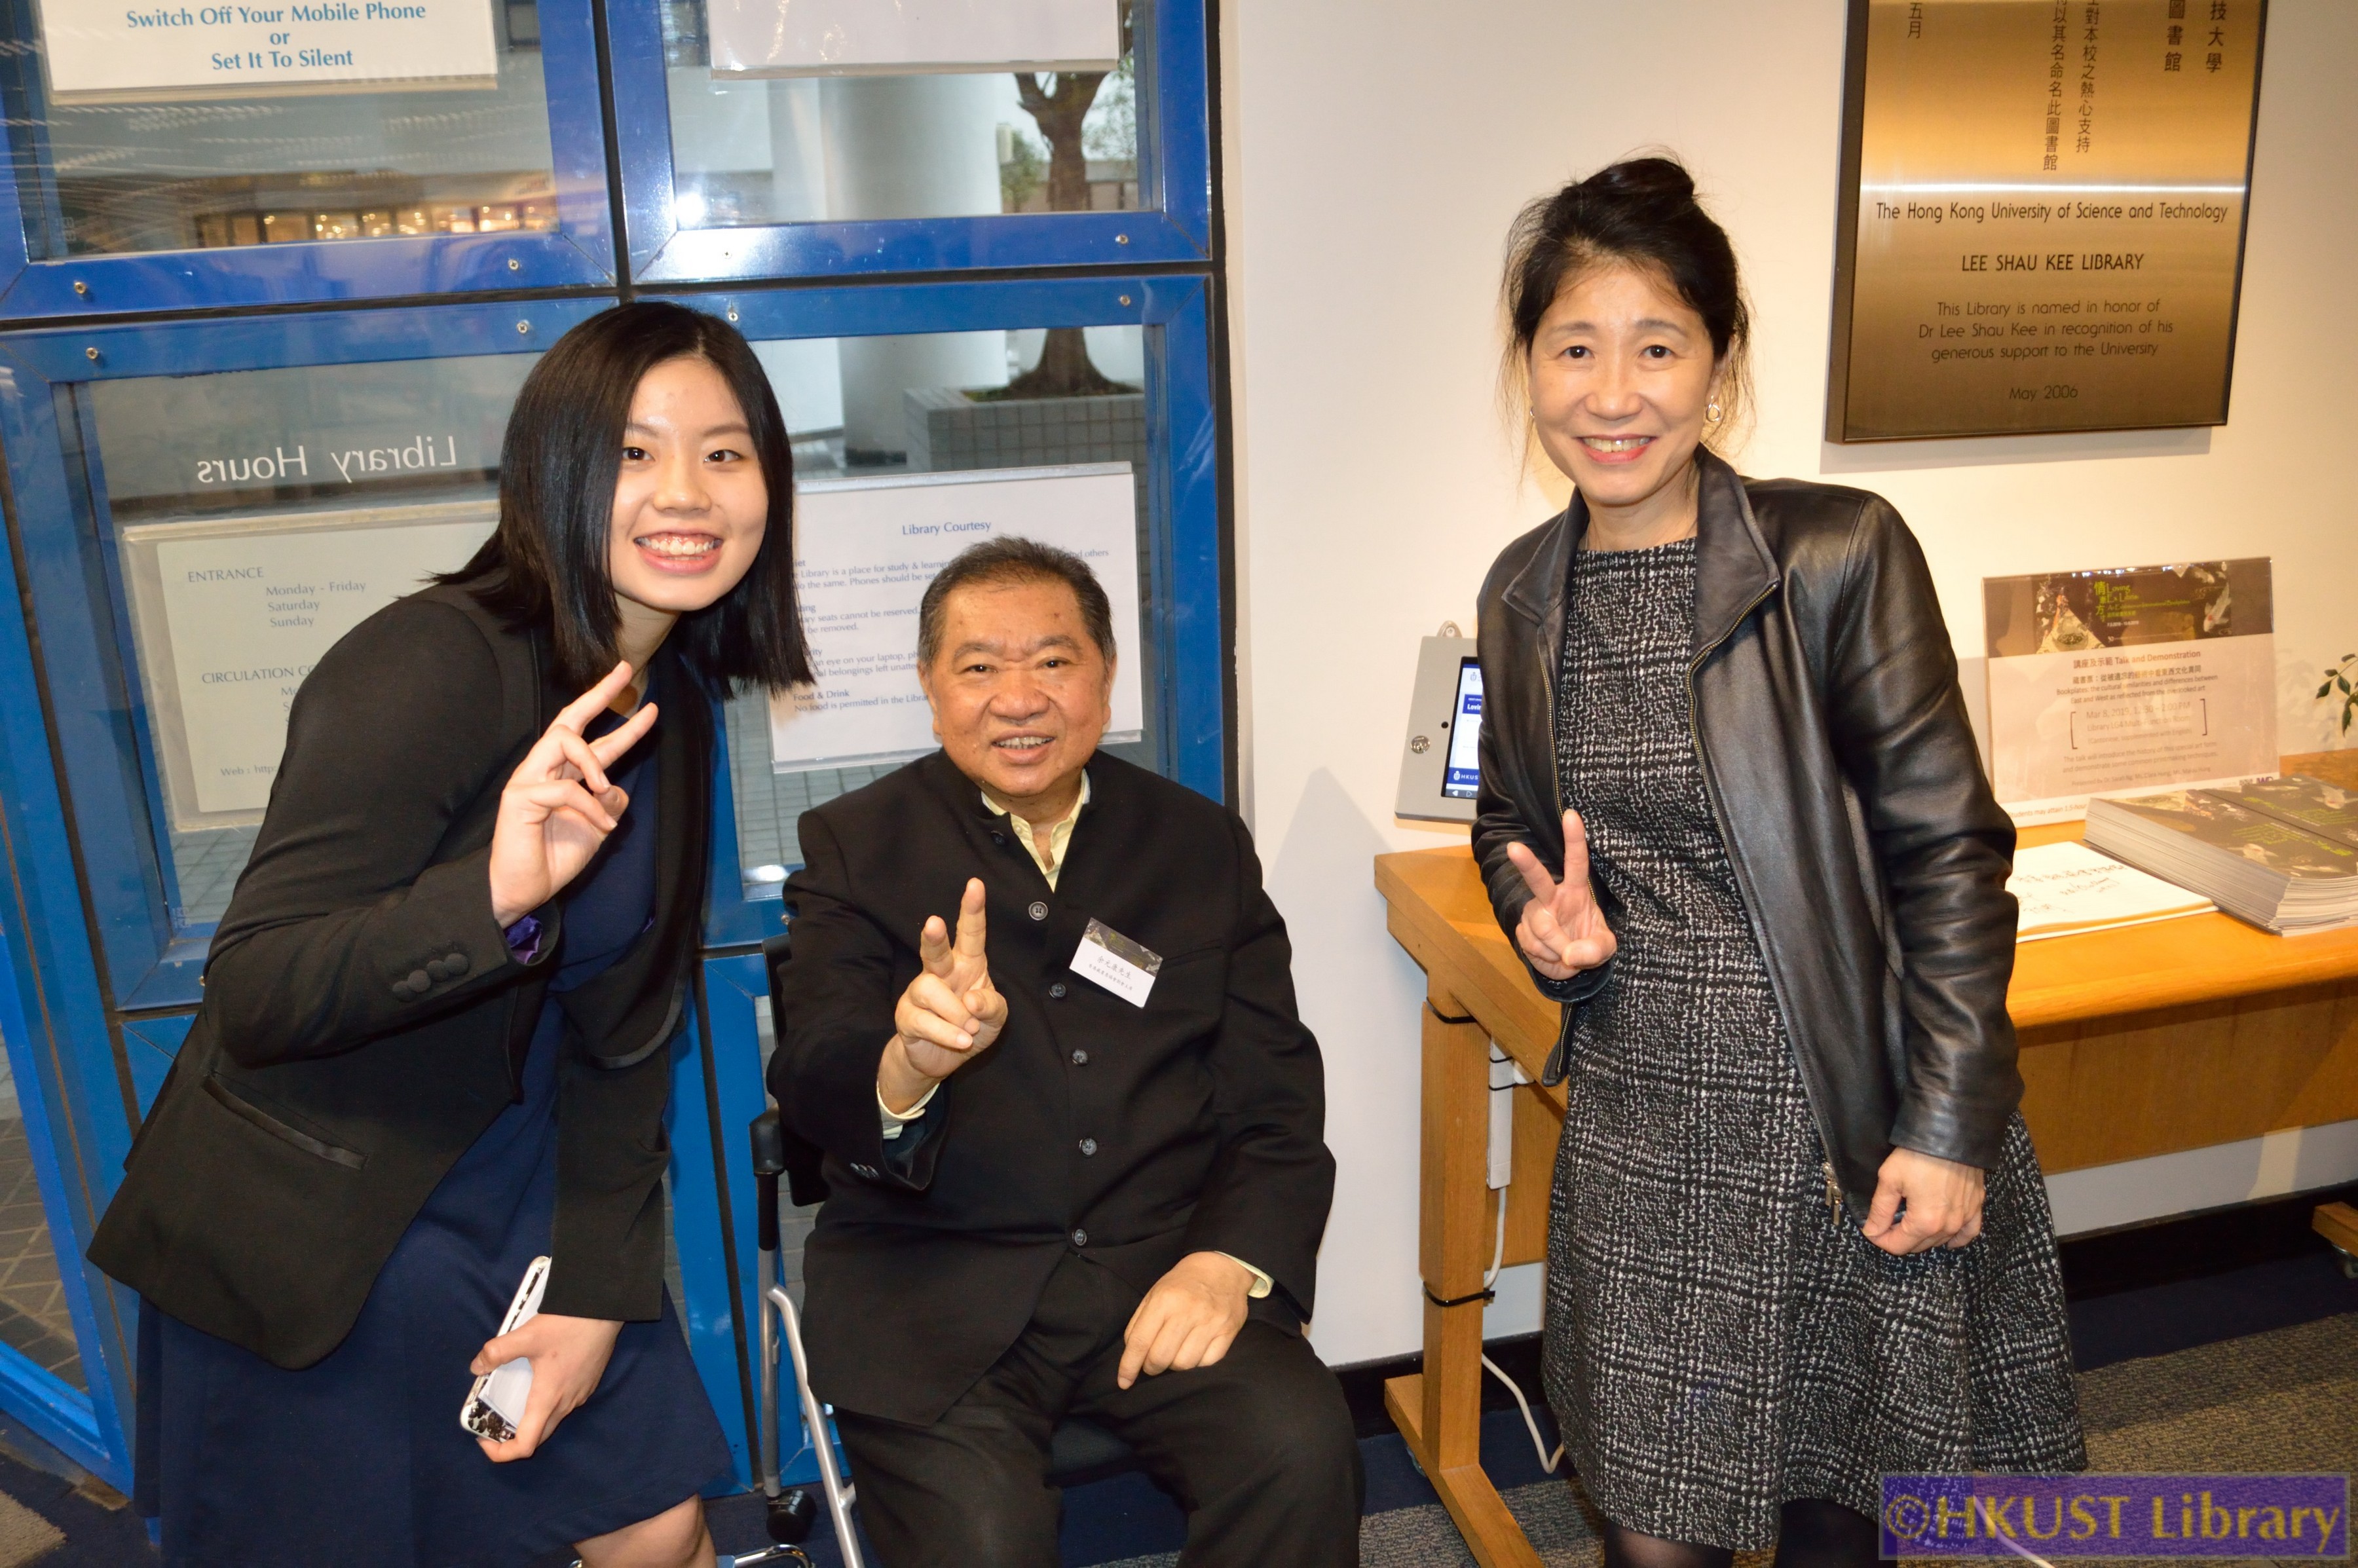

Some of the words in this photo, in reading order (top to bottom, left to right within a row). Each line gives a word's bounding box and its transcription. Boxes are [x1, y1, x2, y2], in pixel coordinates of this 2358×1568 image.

[126, 8, 194, 28] Switch
[200, 7, 232, 25] Off
[238, 6, 284, 23] Your
[292, 3, 359, 22] Mobile
[366, 2, 426, 20] Phone
[1907, 2, 1922, 39] 五月
[270, 31, 290, 45] or
[2164, 0, 2186, 72] 圖書館
[2205, 1, 2226, 73] 技大學
[212, 52, 241, 69] Set
[249, 52, 262, 68] It
[269, 50, 292, 67] To
[299, 48, 354, 65] Silent
[1877, 202, 1900, 219] The
[1908, 202, 1942, 223] Hong
[1951, 202, 1984, 223] Kong
[1992, 202, 2051, 222] University
[2058, 202, 2070, 218] of
[2076, 202, 2122, 218] Science
[2129, 202, 2152, 218] and
[2160, 202, 2228, 222] Technology
[1962, 255, 1987, 271] LEE
[1996, 255, 2037, 271] SHAU
[2046, 255, 2073, 270] KEE
[2082, 254, 2144, 270] LIBRARY
[1938, 302, 1960, 316] This
[1967, 302, 2010, 318] Library
[2017, 303, 2025, 314] is
[2032, 301, 2080, 314] named
[2087, 301, 2097, 313] in
[2104, 299, 2140, 313] honor
[2147, 299, 2160, 312] of
[1919, 324, 1934, 338] Dr
[1940, 324, 1965, 337] Lee
[1972, 323, 2004, 337] Shau
[2011, 322, 2037, 336] Kee
[2044, 322, 2055, 335] in
[2062, 321, 2133, 337] recognition
[2139, 321, 2152, 333] of
[2158, 320, 2173, 333] his
[1932, 346, 1994, 364] generous
[2000, 346, 2049, 361] support
[2055, 345, 2068, 356] to
[2074, 343, 2094, 356] the
[2101, 342, 2158, 358] University
[2010, 387, 2036, 402] May
[2044, 385, 2078, 399] 2006
[902, 523, 941, 536] Library
[944, 521, 992, 532] Courtesy
[188, 567, 264, 582] ENTRANCE
[800, 569, 830, 578] Library
[848, 566, 871, 576] place
[874, 564, 885, 572] for
[888, 562, 908, 572] study
[922, 560, 949, 569] learnin
[850, 577, 880, 586] Phones
[882, 573, 910, 584] should
[266, 584, 315, 597] Monday
[329, 581, 366, 593] Friday
[268, 600, 320, 613] Saturday
[270, 616, 314, 629] Sunday
[818, 613, 838, 622] seats
[840, 612, 869, 620] cannot
[821, 622, 859, 633] removed.
[856, 656, 874, 665] your
[877, 653, 905, 662] laptop,
[2147, 650, 2201, 662] Demonstration
[202, 667, 294, 684] CIRCULATION
[829, 667, 873, 677] belongings
[876, 663, 888, 672] left
[891, 663, 917, 671] unatte
[793, 692, 814, 701] Food
[827, 689, 850, 698] Drink
[810, 701, 829, 711] food
[839, 697, 878, 710] permitted
[891, 696, 904, 704] the
[220, 766, 244, 776] Web
